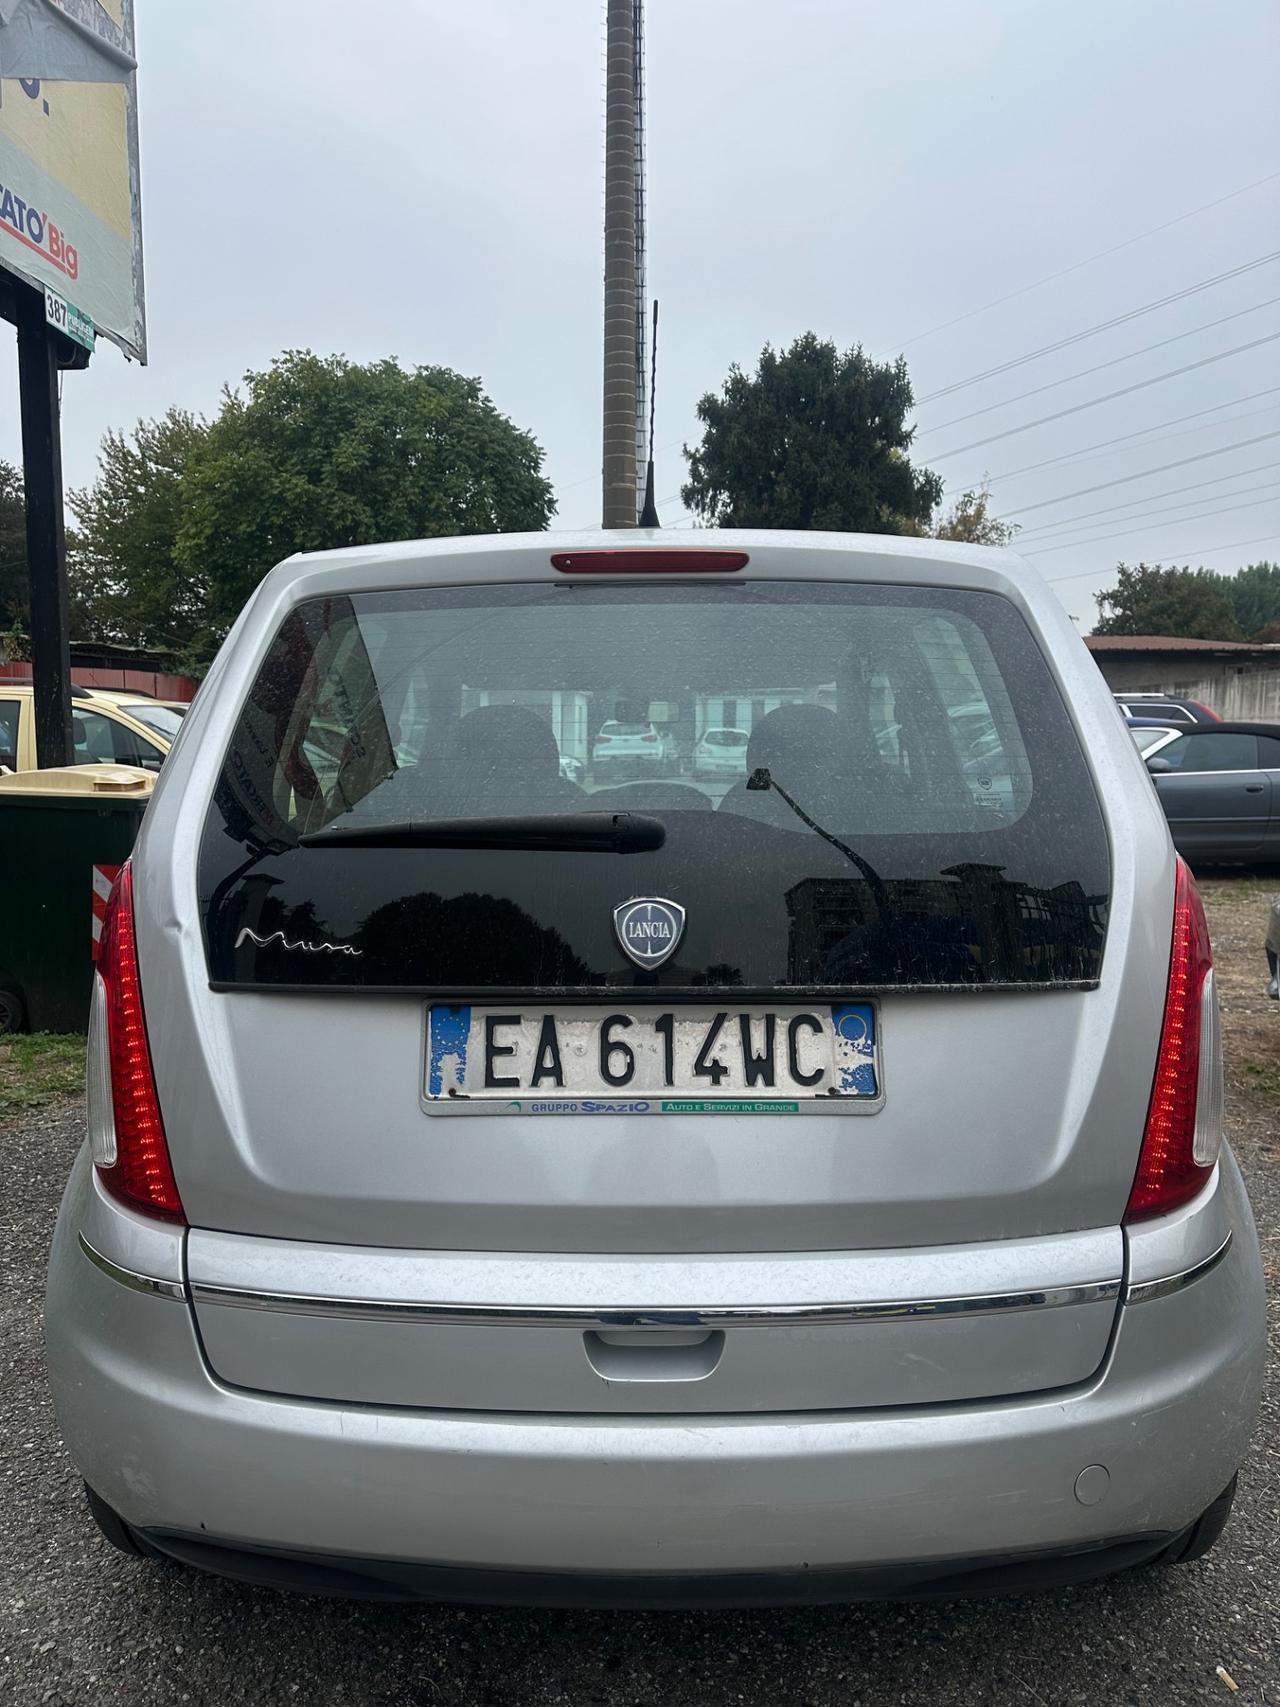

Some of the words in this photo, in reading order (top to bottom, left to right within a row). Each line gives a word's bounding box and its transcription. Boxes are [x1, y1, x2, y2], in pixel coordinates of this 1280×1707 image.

[47, 294, 66, 327] 387
[629, 922, 671, 937] LANCIA
[234, 927, 363, 955] Musa
[485, 1014, 566, 1088] EA
[600, 1012, 825, 1088] 614WC
[531, 1103, 578, 1112] GRUPPO
[581, 1101, 650, 1112] SPAZIO
[666, 1103, 693, 1112] AUTO
[695, 1104, 702, 1112] E
[703, 1103, 740, 1112] SERVIZI
[741, 1103, 752, 1112] IN
[754, 1103, 796, 1112] GRANDE
